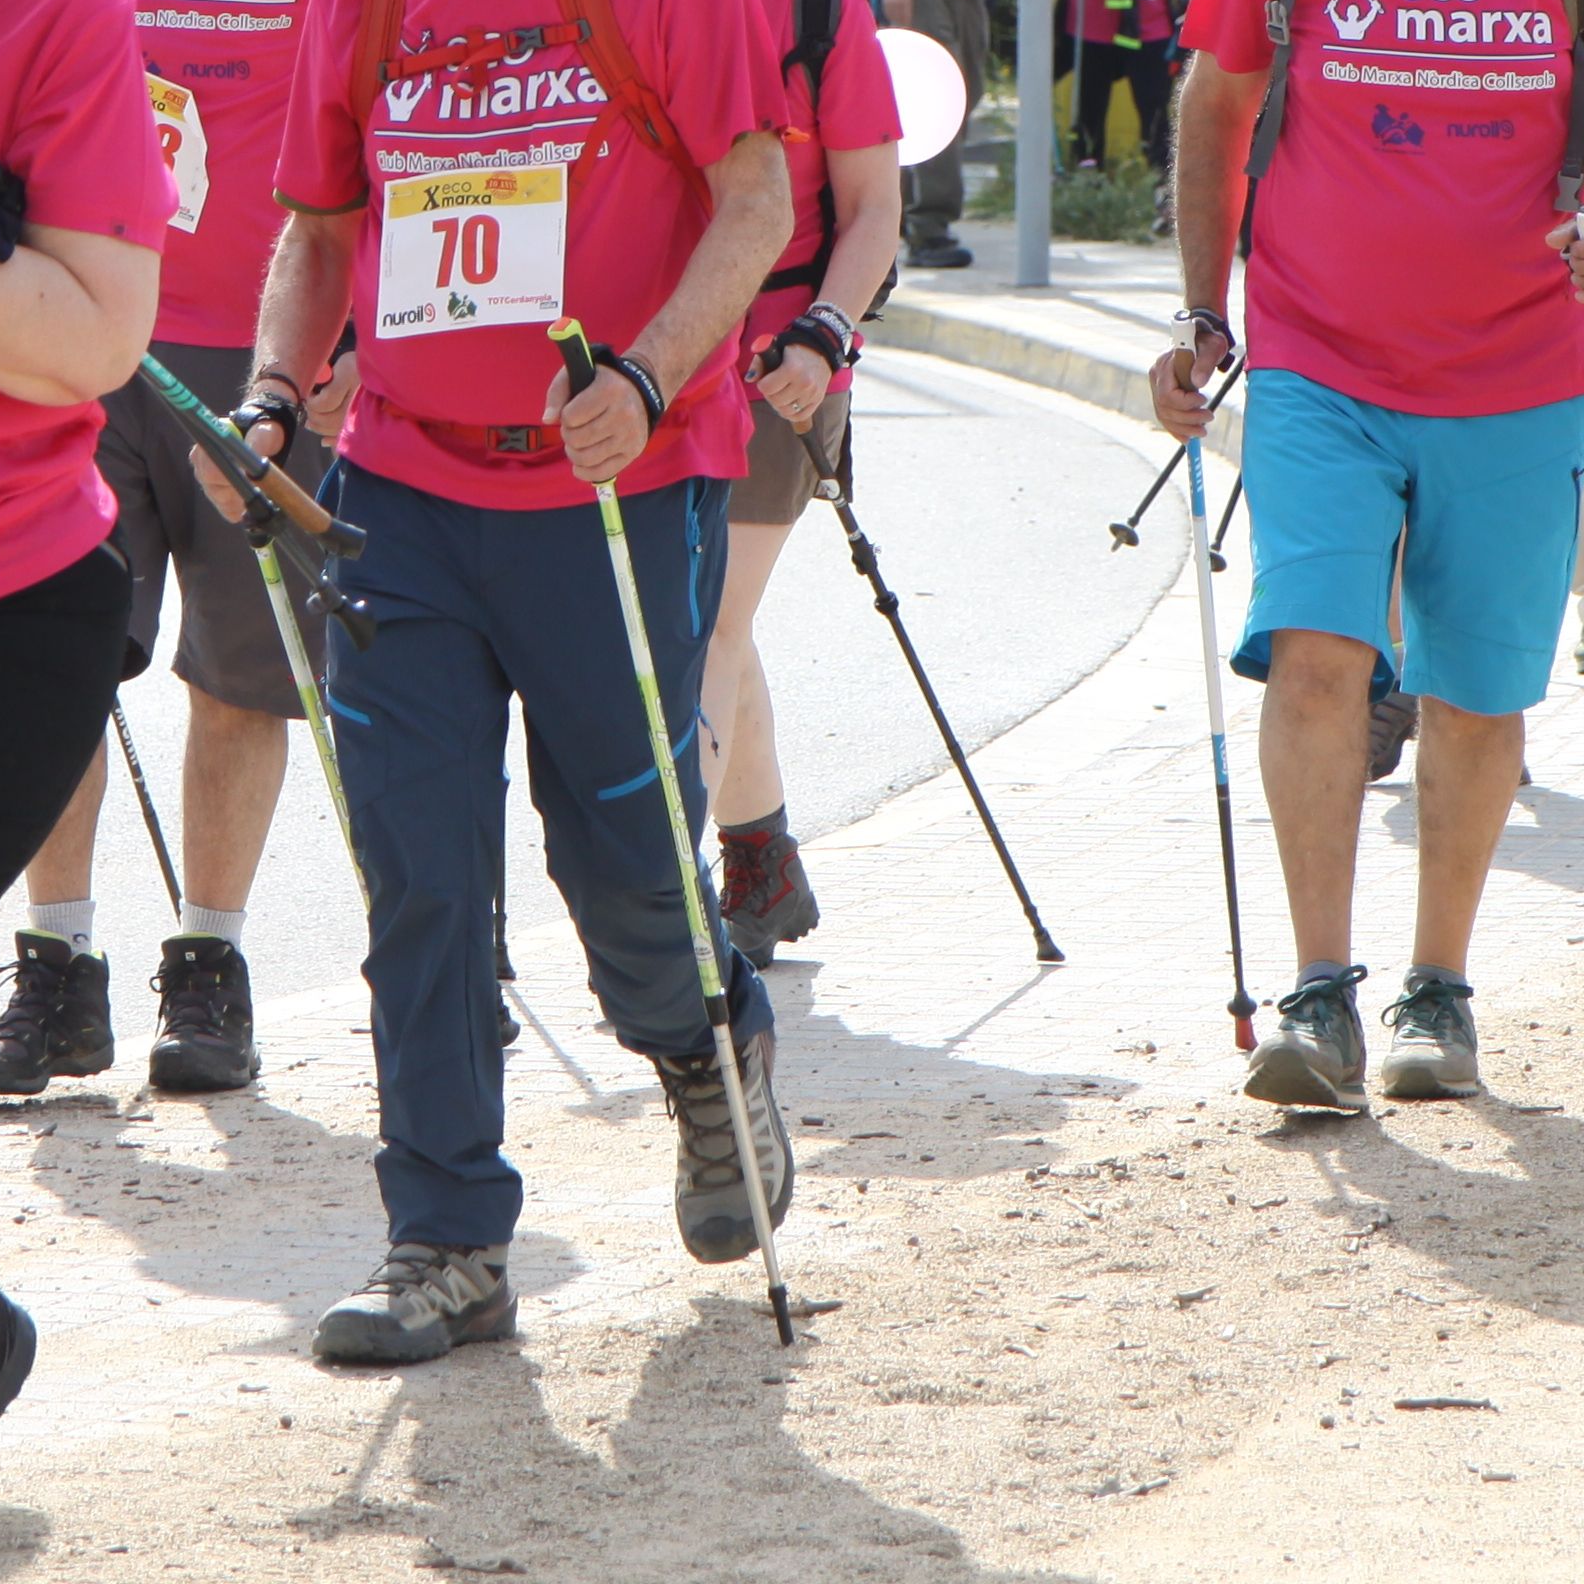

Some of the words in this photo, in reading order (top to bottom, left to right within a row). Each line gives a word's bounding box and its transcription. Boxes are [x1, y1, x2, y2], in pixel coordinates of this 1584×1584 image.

[157, 11, 214, 29] Nòrdica
[218, 14, 292, 30] Collserola
[1396, 7, 1552, 44] marxa
[1323, 61, 1358, 81] Club
[1362, 66, 1413, 85] Marxa
[1416, 72, 1479, 90] Nòrdica
[1484, 71, 1555, 90] Collserola
[438, 66, 609, 119] marxa
[406, 153, 456, 171] Marxa
[423, 185, 441, 211] X
[442, 181, 472, 193] eco
[441, 193, 492, 207] marxa
[432, 215, 500, 289] 70
[382, 304, 423, 327] nuroil
